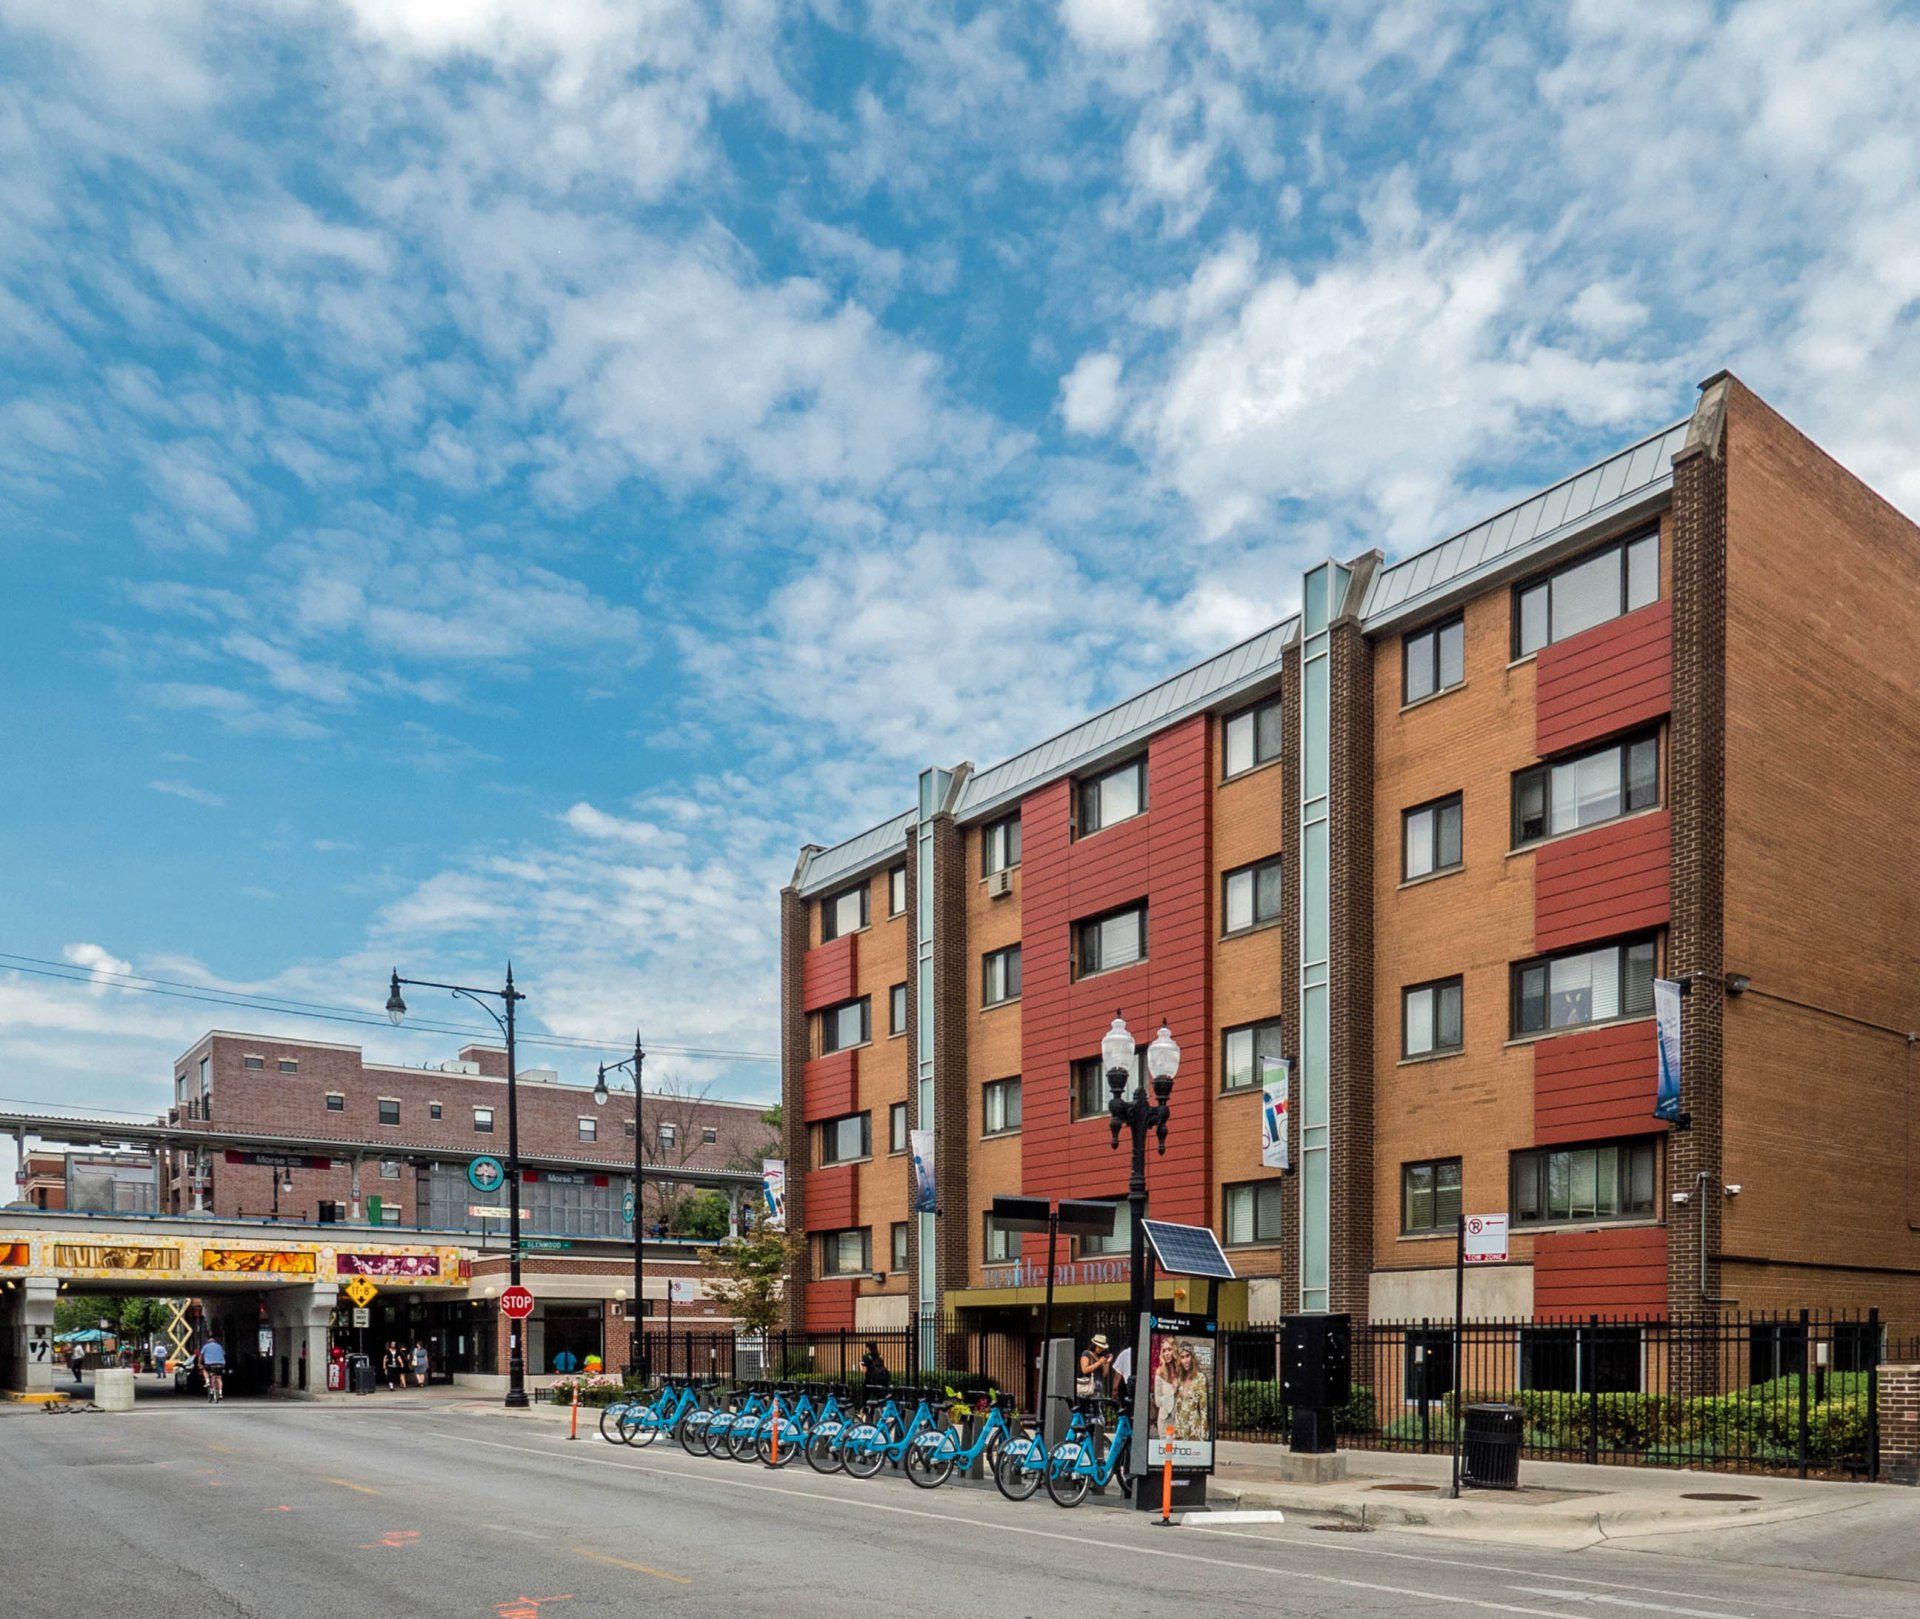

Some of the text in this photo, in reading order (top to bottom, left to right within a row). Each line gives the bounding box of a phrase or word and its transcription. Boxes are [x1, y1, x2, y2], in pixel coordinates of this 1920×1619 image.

[256, 1155, 285, 1165] Morse
[547, 1174, 572, 1183] Morse
[527, 1241, 561, 1249] GLENWOOD
[502, 1295, 532, 1309] STOP
